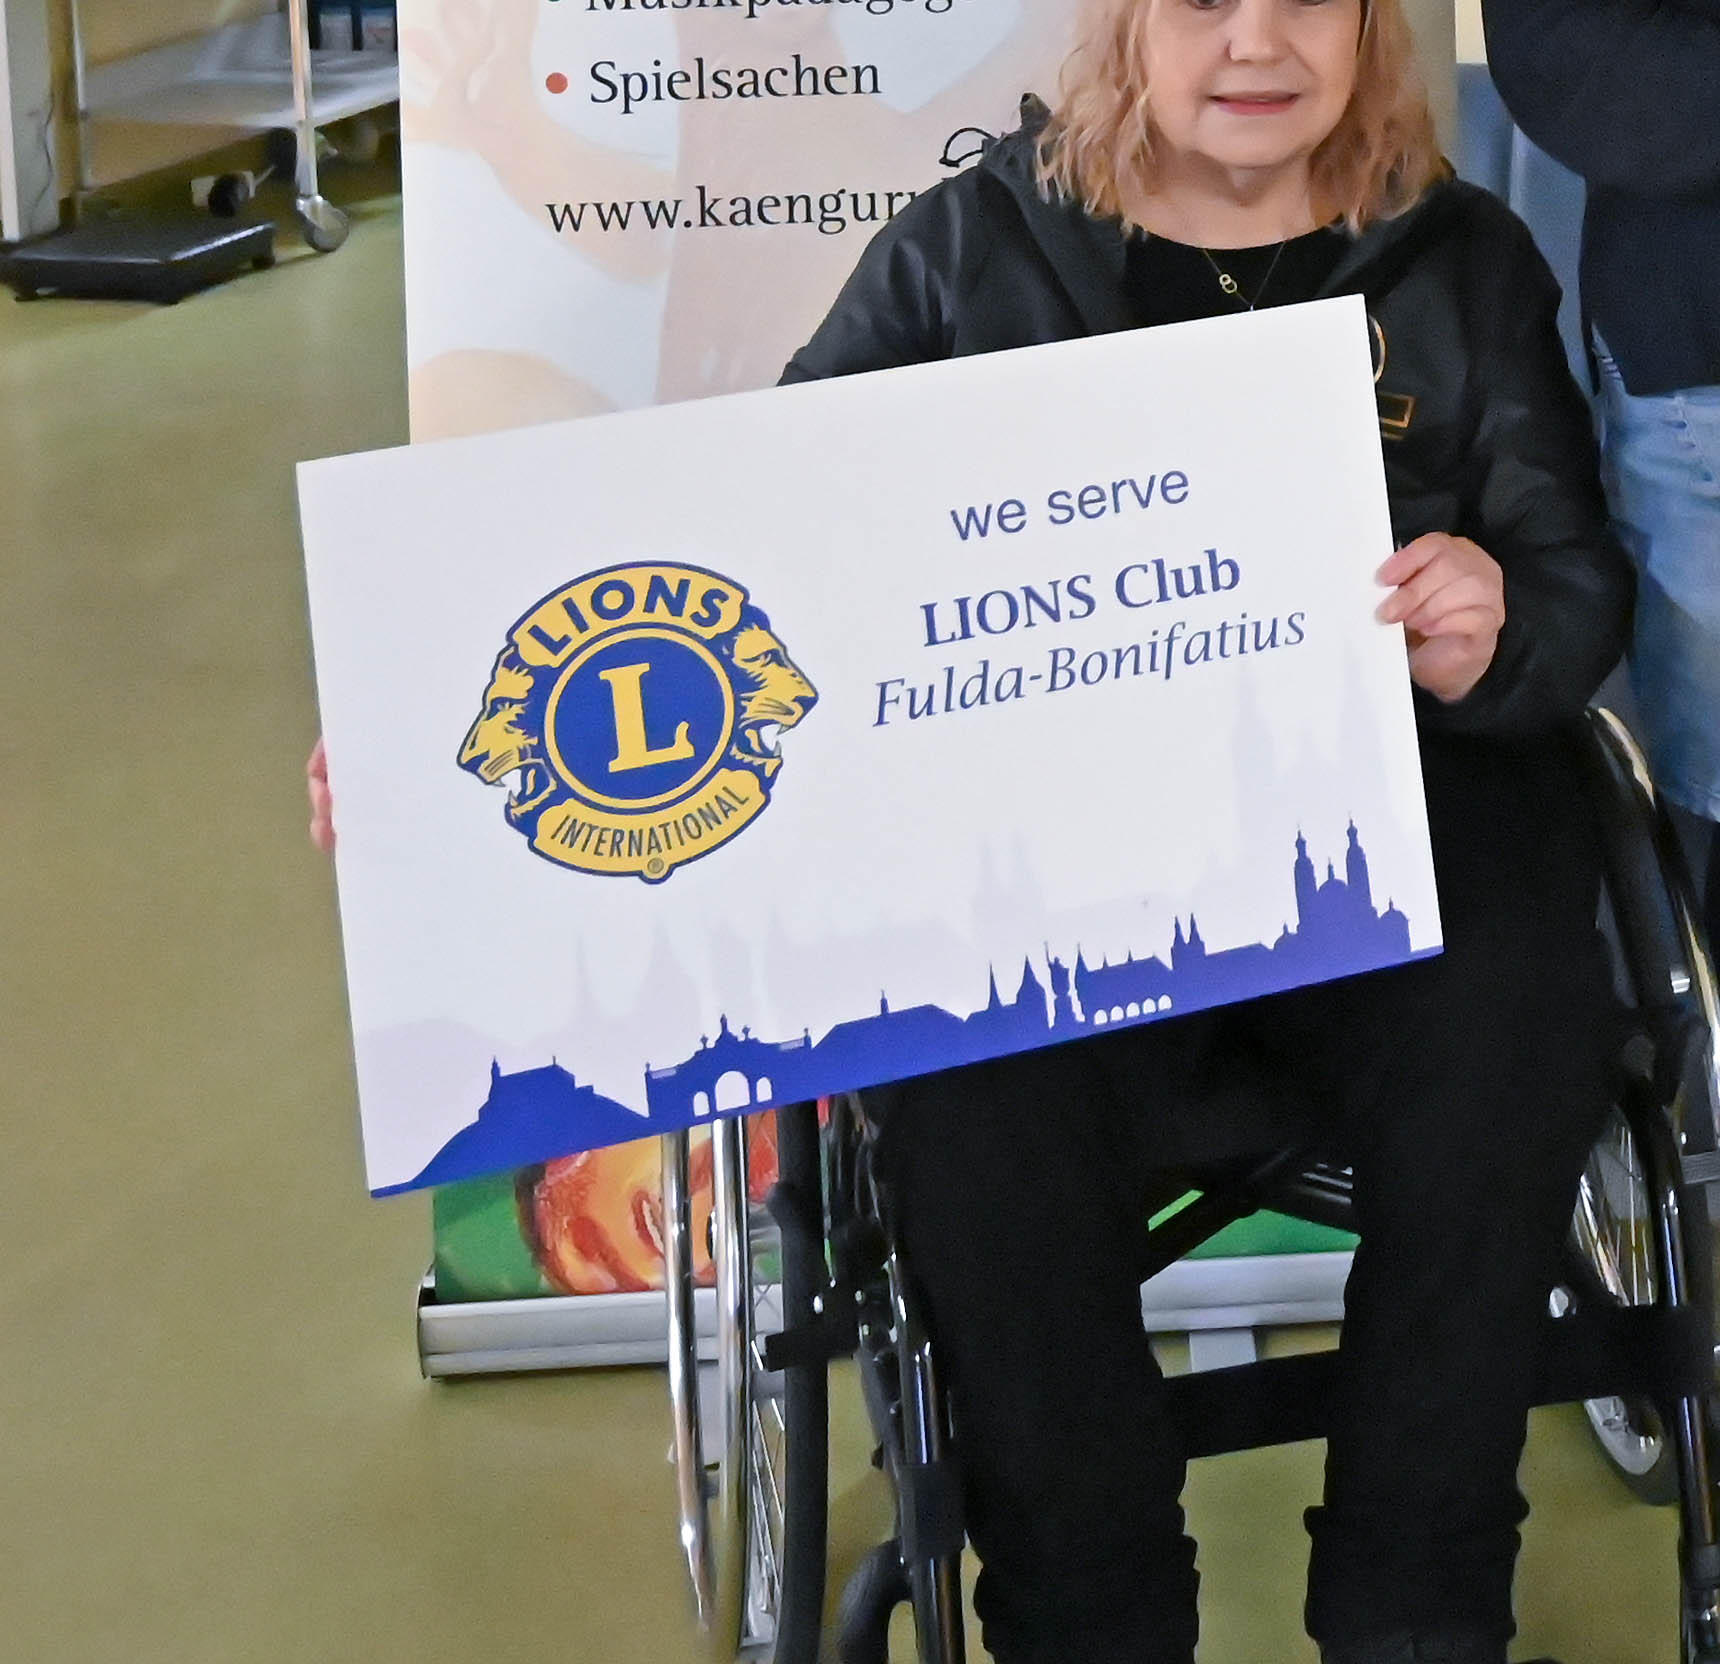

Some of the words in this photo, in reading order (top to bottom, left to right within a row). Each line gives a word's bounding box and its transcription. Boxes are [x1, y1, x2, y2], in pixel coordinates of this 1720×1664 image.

[588, 54, 883, 115] Spielsachen
[545, 183, 916, 237] www.kaengur
[949, 490, 1028, 543] we
[1046, 465, 1191, 523] serve
[527, 574, 730, 657] LIONS
[918, 572, 1097, 648] LIONS
[1112, 549, 1243, 609] Club
[871, 608, 1308, 728] Fulda-Bonifatius
[550, 785, 750, 858] INTERNATIONAL
